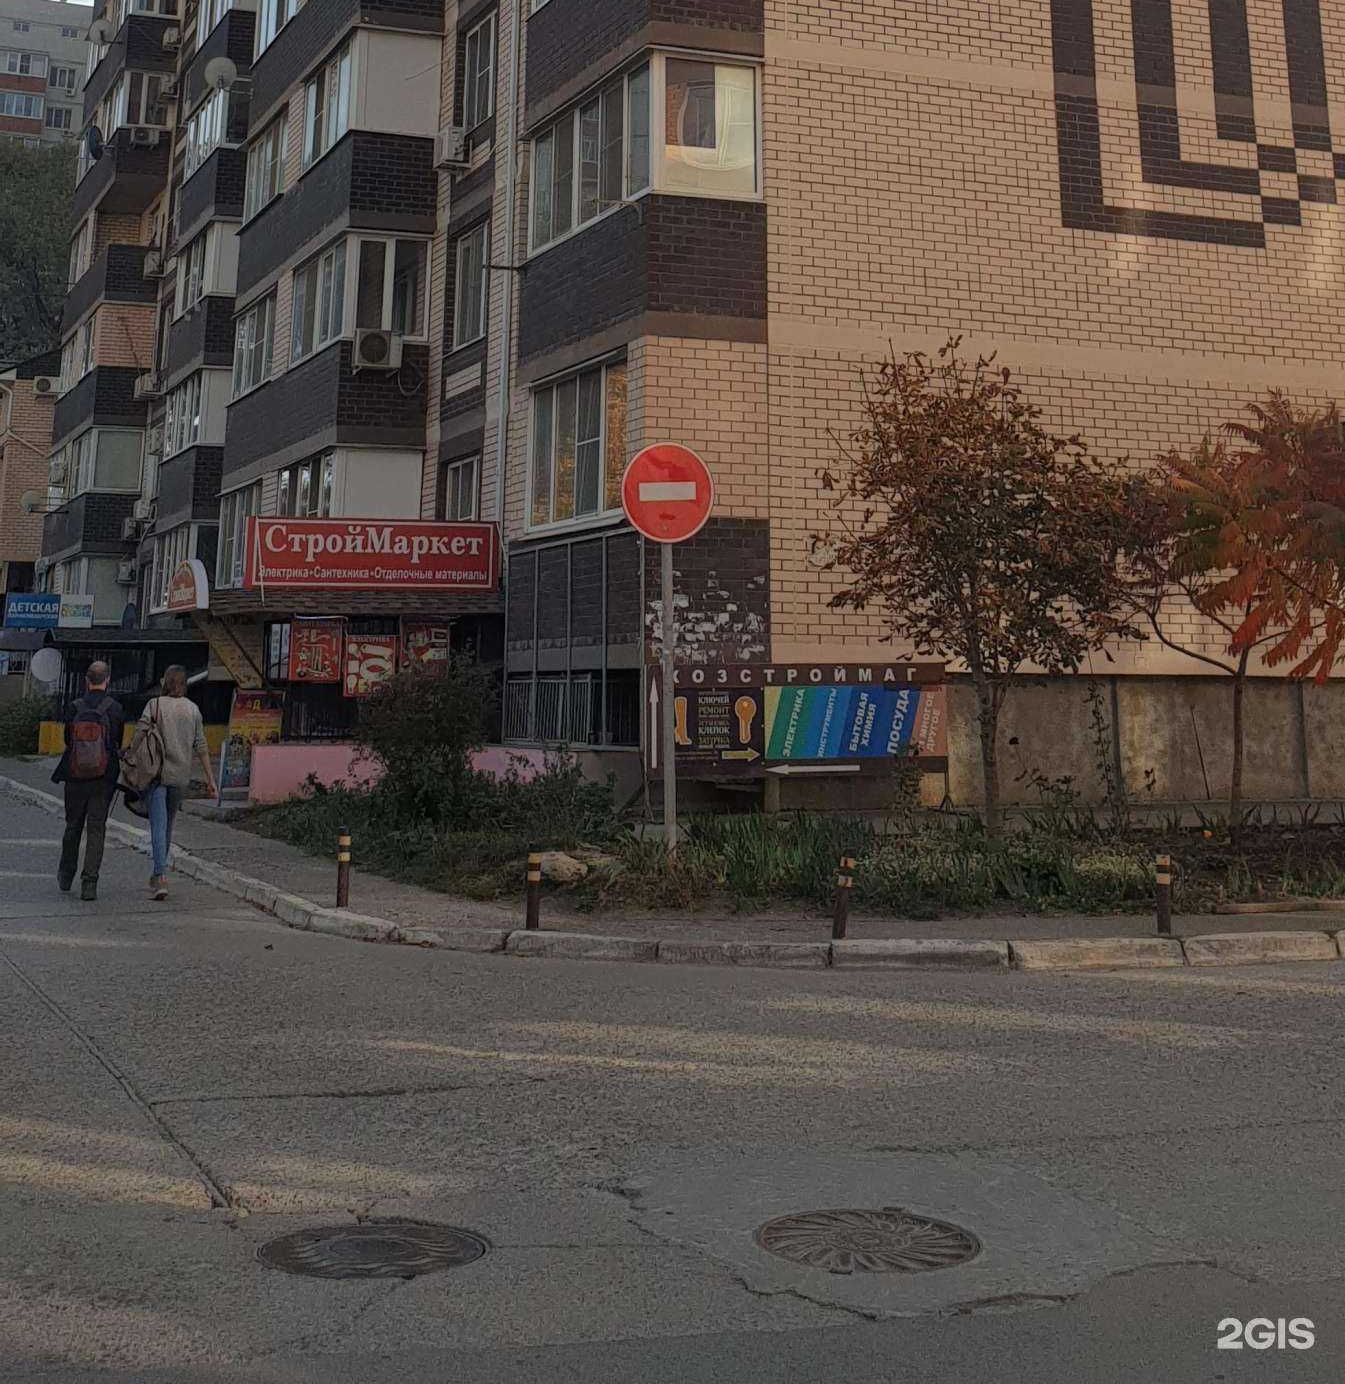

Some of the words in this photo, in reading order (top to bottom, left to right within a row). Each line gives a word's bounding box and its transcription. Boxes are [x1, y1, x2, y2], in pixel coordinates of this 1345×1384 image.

[265, 524, 483, 564] СтройМаркет
[314, 566, 369, 580] Сантехника
[374, 567, 433, 581] Отделочные
[435, 570, 487, 583] материалы
[8, 602, 59, 613] ДЕТСКАЯ
[698, 695, 730, 704] КЛЮЧЕЙ
[698, 706, 730, 715] РЕМОНТ
[920, 692, 935, 737] МНОГОЕ
[782, 689, 805, 757] ЭЛЕКТРИКА
[849, 693, 869, 752] БЫТОВАЯ
[860, 704, 877, 746] ХИМИЯ
[887, 689, 910, 754] ПОСУДА
[927, 709, 940, 752] ДРУГОЕ
